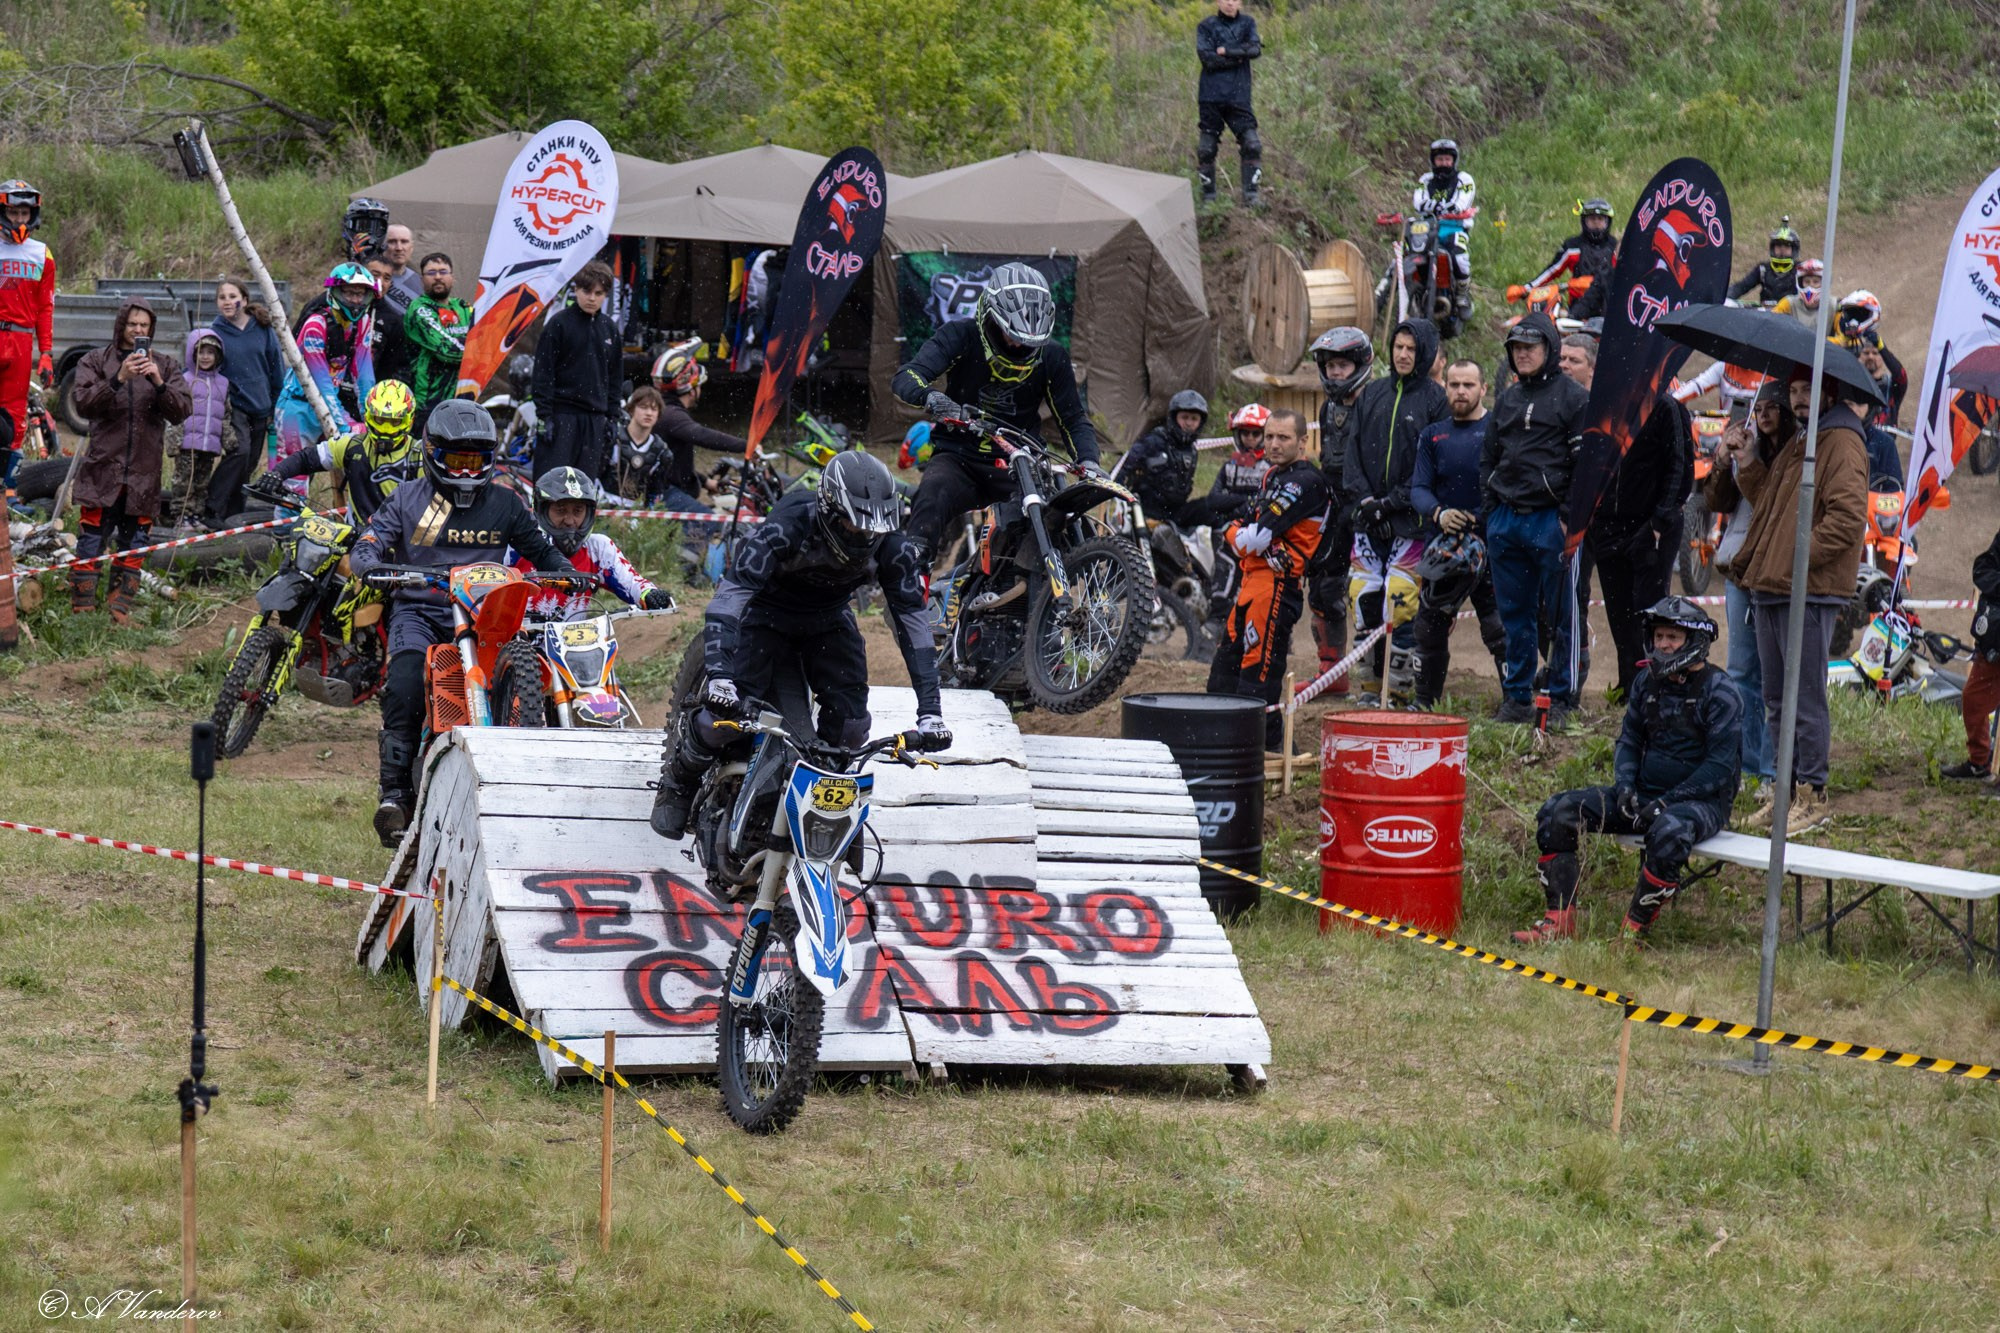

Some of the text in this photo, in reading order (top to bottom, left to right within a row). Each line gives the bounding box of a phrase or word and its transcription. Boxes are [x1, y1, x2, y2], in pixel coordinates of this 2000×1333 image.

[527, 136, 602, 172] СТАНКИ ЧПУ
[817, 160, 882, 208] ENDURO
[511, 186, 606, 213] HYPERCUT
[1981, 186, 2000, 217] СТ
[1638, 178, 1725, 247] ENDURO
[513, 216, 594, 251] ДЛЯ РЕЗКИ МЕТАЛЛА
[0, 260, 37, 275] EATT
[1628, 284, 1688, 332] СТА
[314, 525, 327, 536] 19
[478, 571, 496, 579] 73
[576, 630, 585, 640] 3
[708, 694, 736, 708] FOX
[835, 779, 854, 787] CLIMB
[824, 788, 845, 805] 62
[1367, 828, 1434, 843] SINTEC
[733, 922, 759, 993] PROGASI
